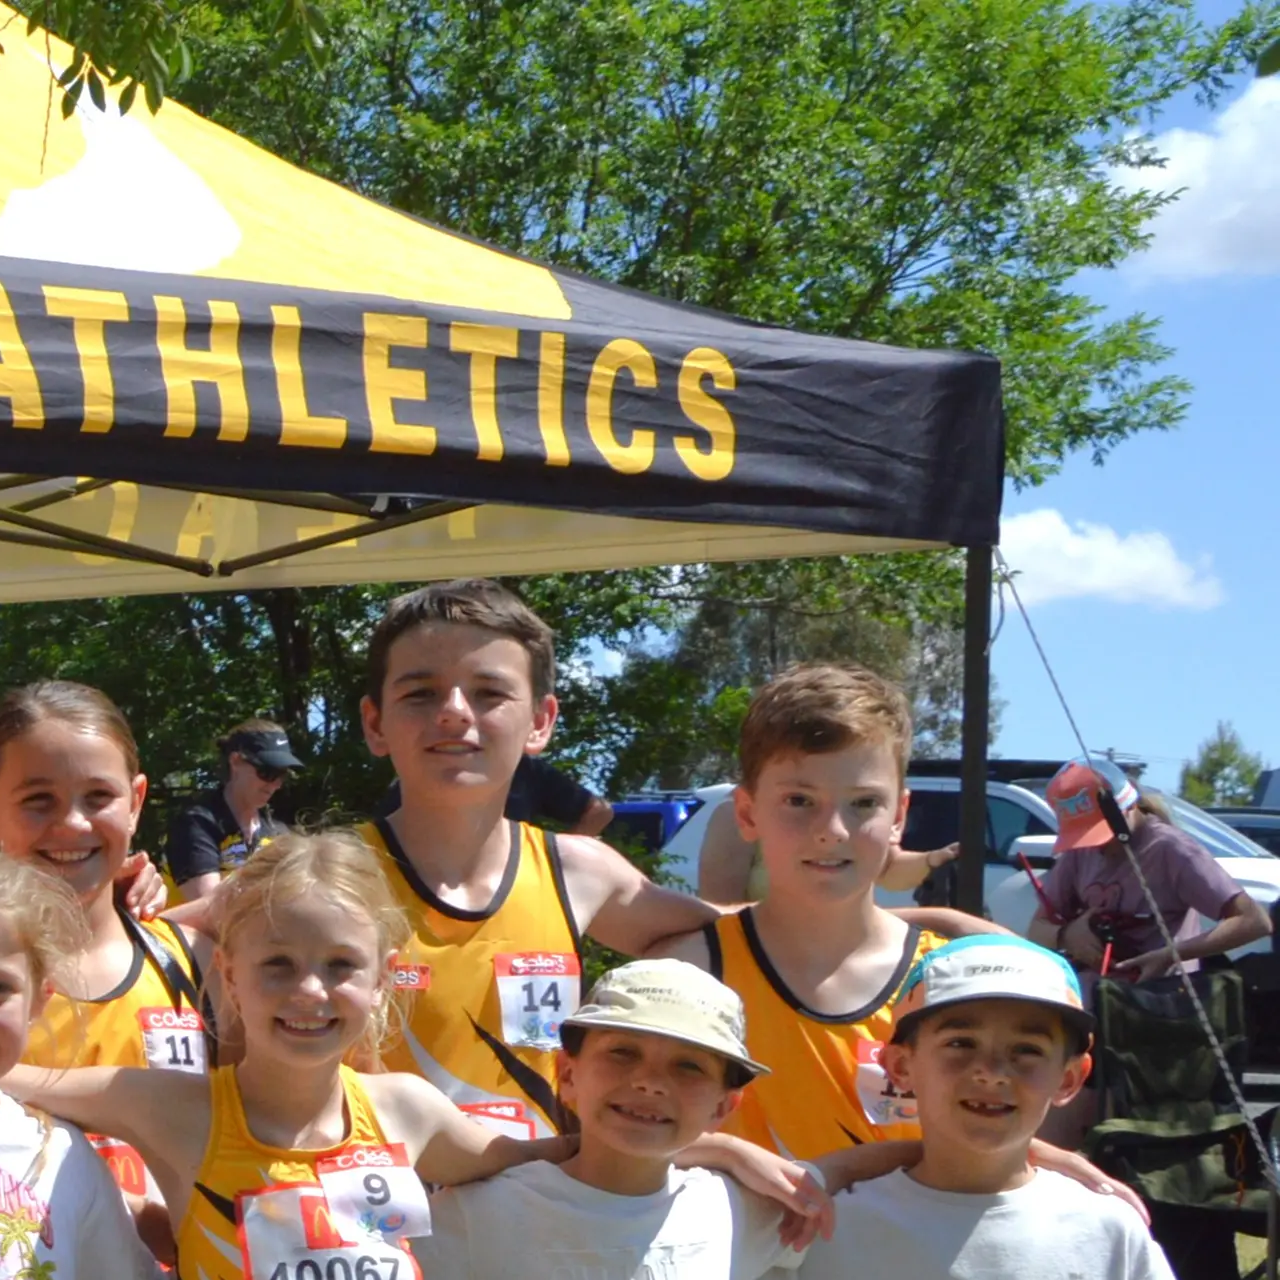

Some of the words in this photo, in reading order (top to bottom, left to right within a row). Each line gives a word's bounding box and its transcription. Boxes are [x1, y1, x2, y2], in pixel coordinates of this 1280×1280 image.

[521, 980, 562, 1013] 14
[149, 1009, 199, 1028] coles
[165, 1035, 194, 1066] 11
[362, 1173, 391, 1206] 9
